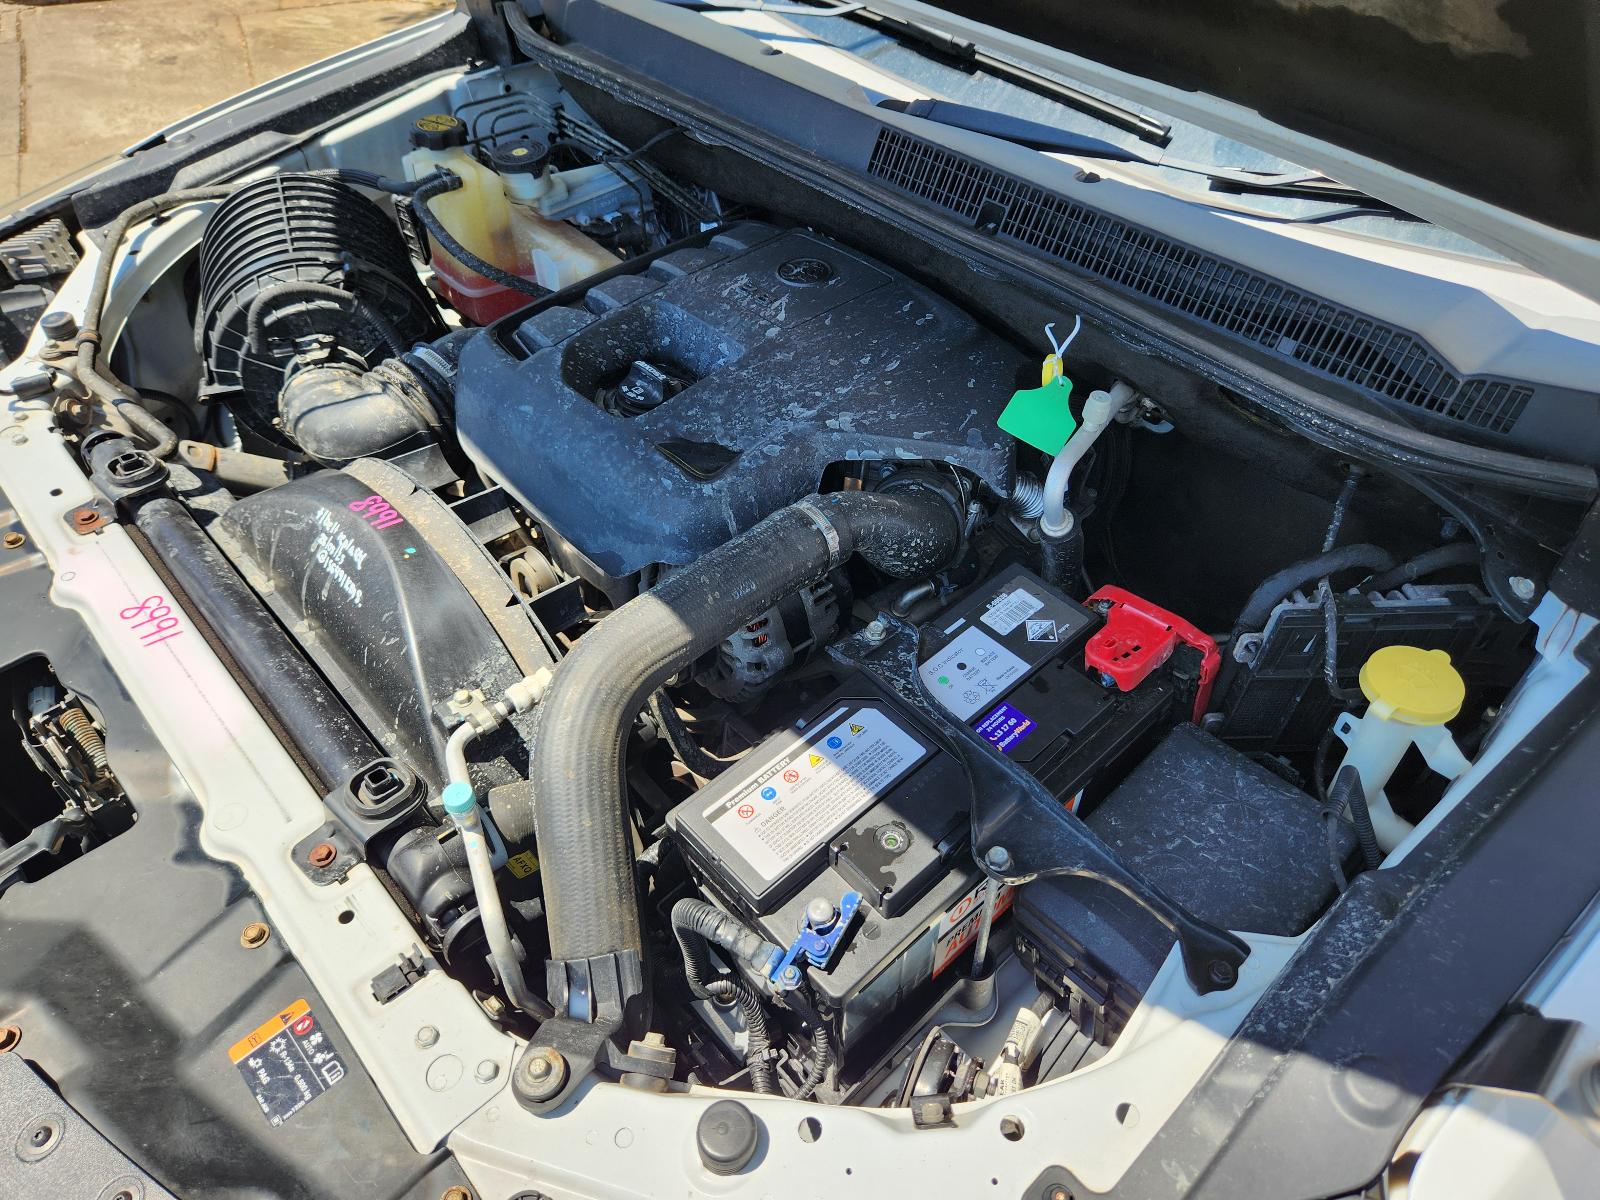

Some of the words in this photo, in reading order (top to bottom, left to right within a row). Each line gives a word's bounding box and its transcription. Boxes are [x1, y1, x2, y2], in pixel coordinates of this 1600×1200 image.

[349, 495, 403, 530] 8991
[120, 596, 183, 647] 8991
[725, 783, 759, 808] Premium
[757, 757, 791, 784] BATTERY
[761, 806, 786, 827] DANGER
[302, 1040, 314, 1055] AUTO
[257, 1068, 270, 1085] PAG
[279, 1051, 295, 1072] R-134a
[302, 1089, 312, 1101] kg
